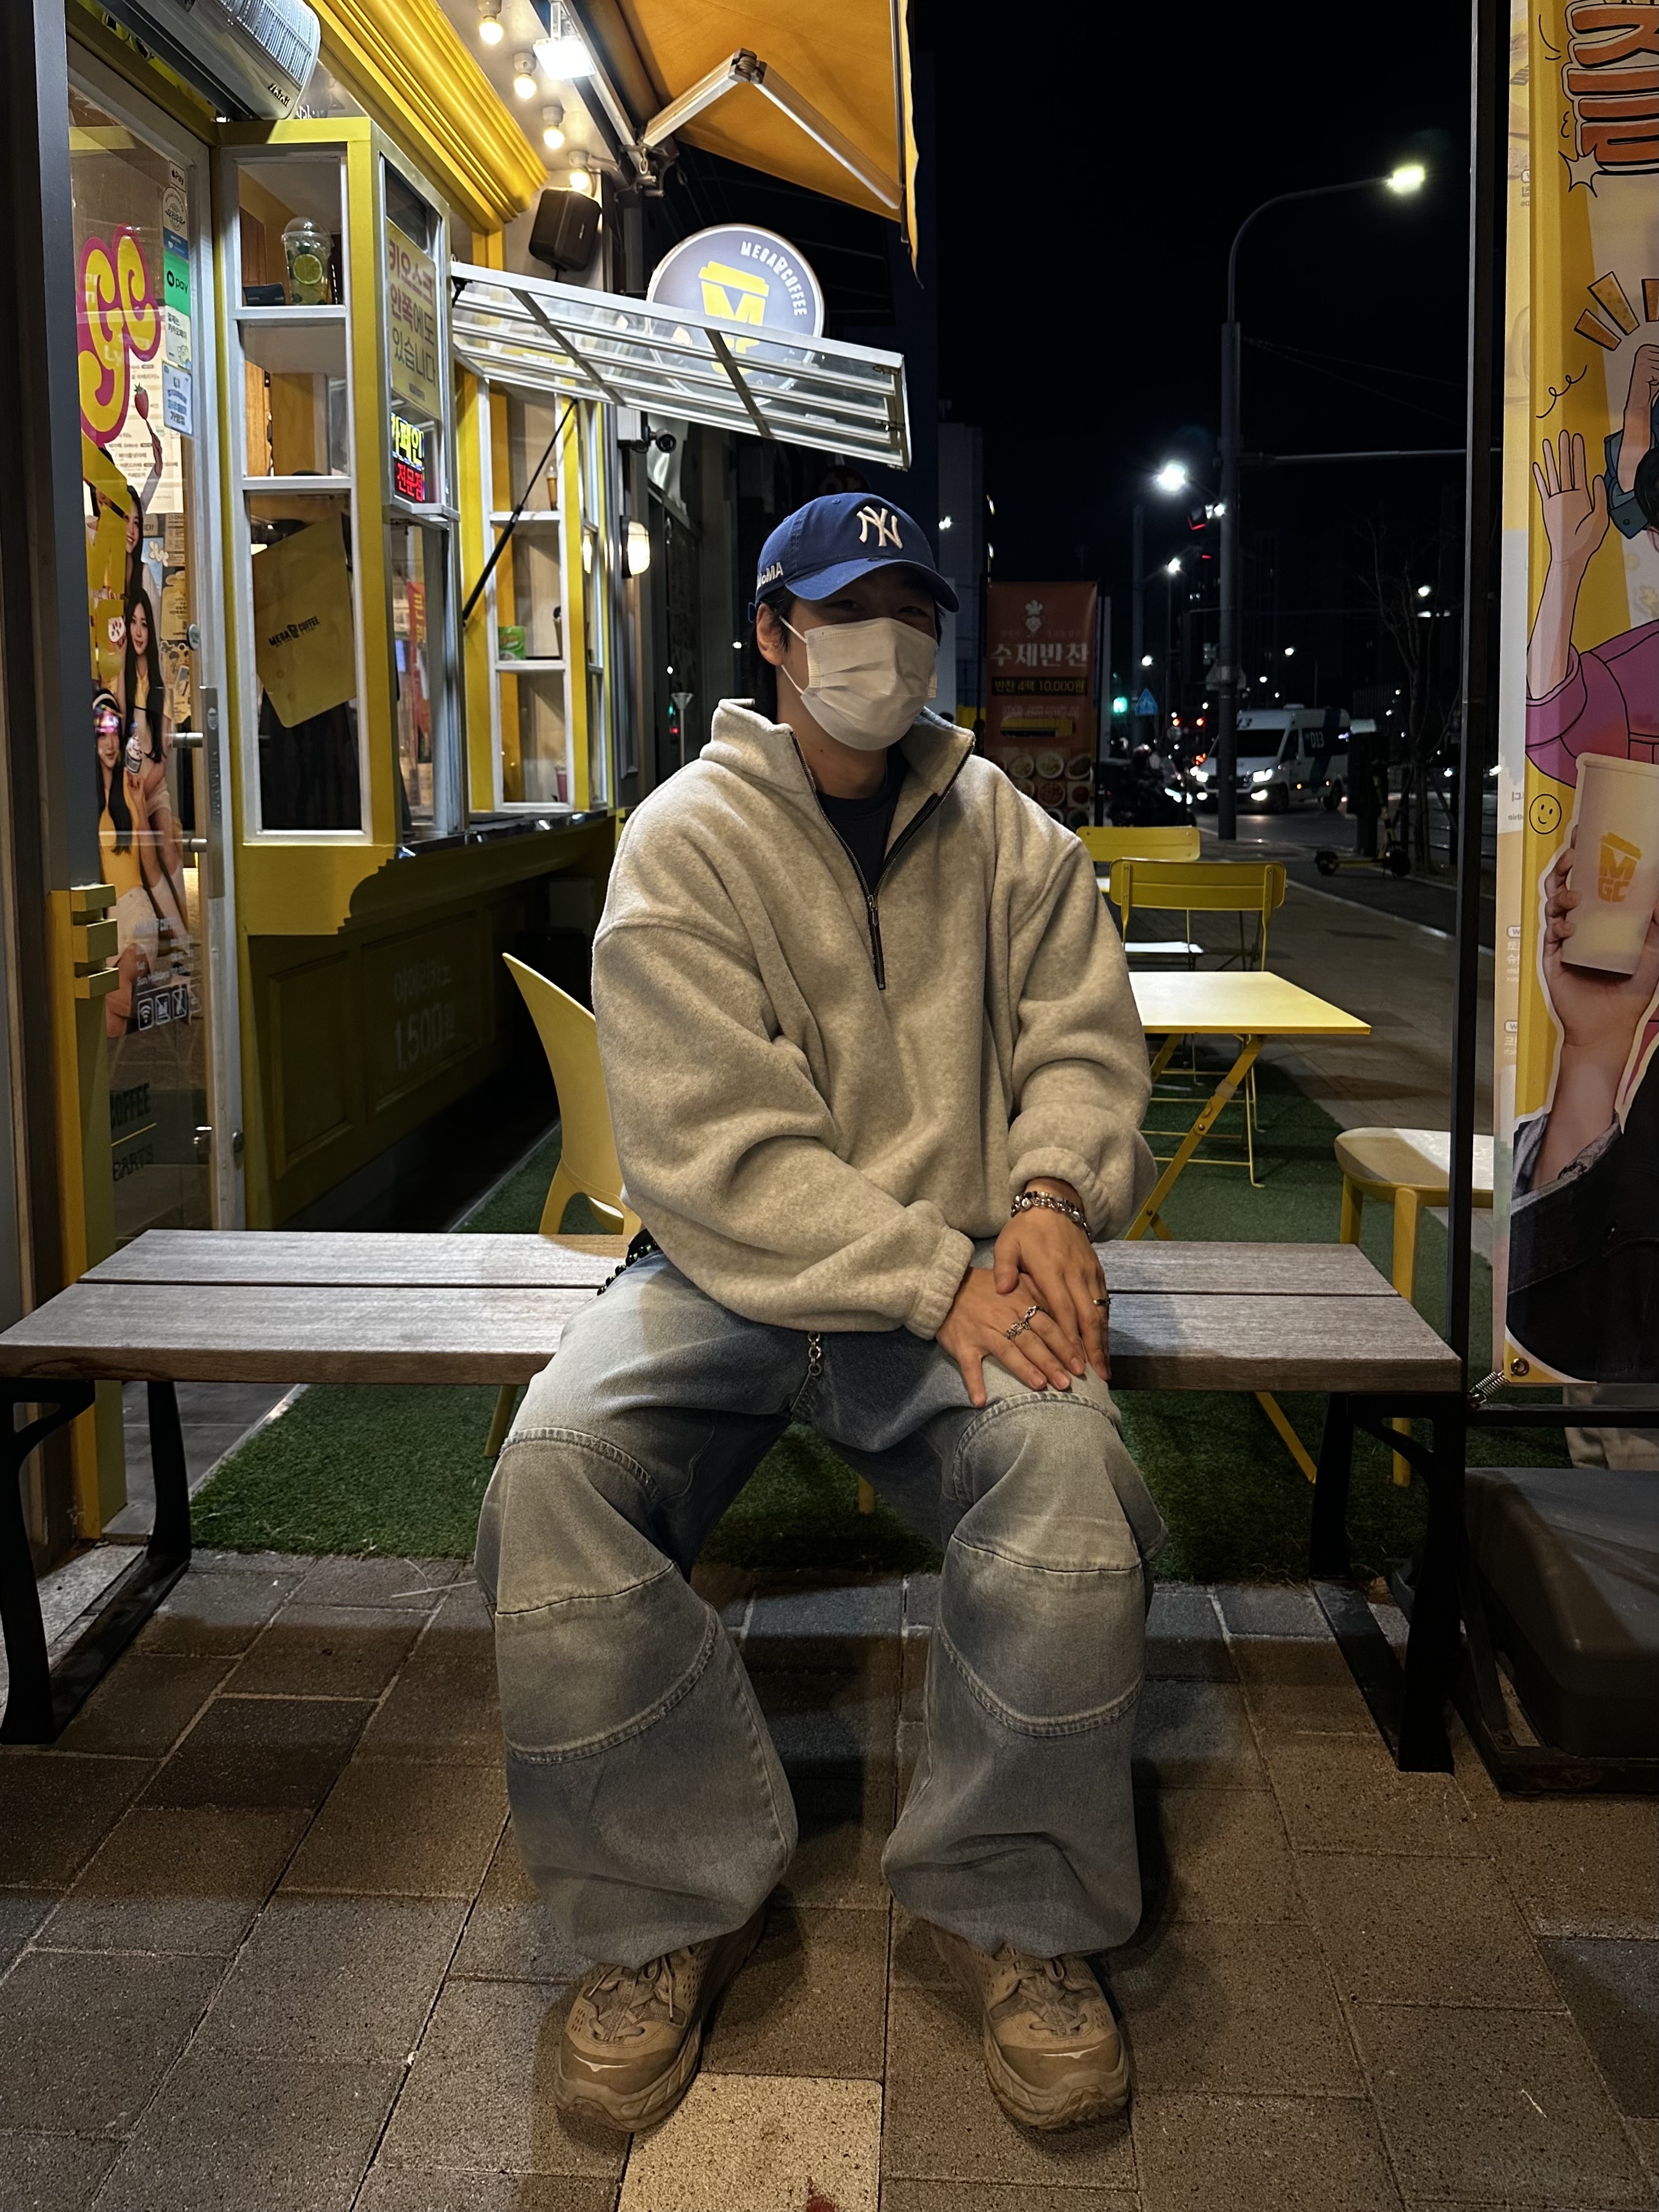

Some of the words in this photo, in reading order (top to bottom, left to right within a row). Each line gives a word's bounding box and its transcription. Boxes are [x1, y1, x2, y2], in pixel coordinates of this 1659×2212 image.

[176, 278, 188, 294] pay
[389, 239, 434, 307] 키오스크
[740, 241, 778, 272] MEGA
[780, 268, 807, 315] COFFEE
[393, 327, 436, 388] 있습니다
[397, 462, 423, 502] 전문점
[856, 506, 903, 550] NY
[297, 616, 320, 632] COFFEE
[991, 643, 1089, 667] 수제반찬
[995, 679, 1015, 692] 반찬
[1018, 679, 1034, 692] 4팩
